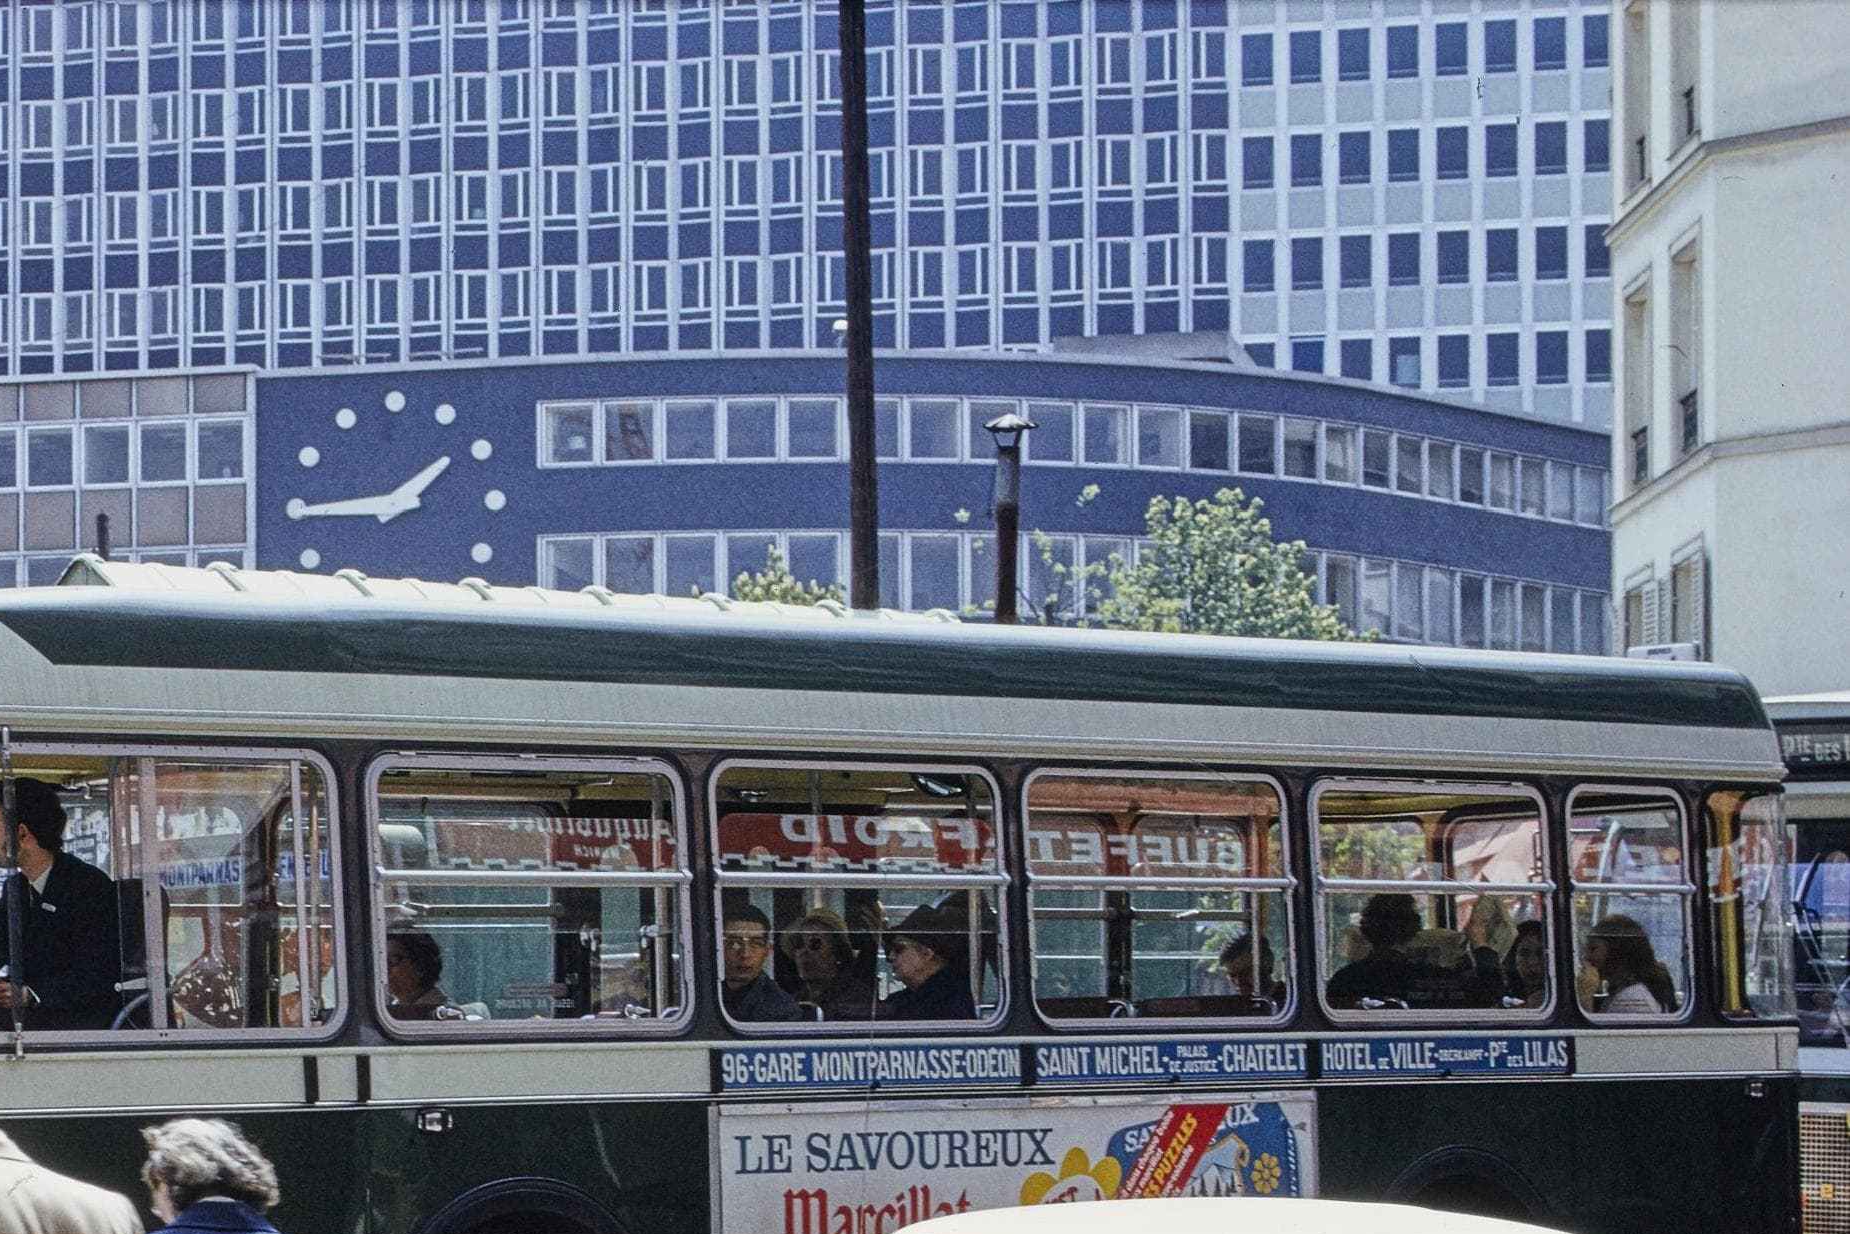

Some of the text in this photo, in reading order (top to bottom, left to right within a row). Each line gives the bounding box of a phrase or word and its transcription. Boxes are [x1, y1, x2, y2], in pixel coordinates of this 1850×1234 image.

[1036, 1046, 1091, 1077] SAINT
[1176, 1045, 1209, 1058] PALAIS
[1322, 1042, 1376, 1071] HOTEL
[1524, 1040, 1569, 1068] LILAS
[735, 1127, 1056, 1175] LE SAVOUREUX
[1153, 1111, 1198, 1185] PUZZLES
